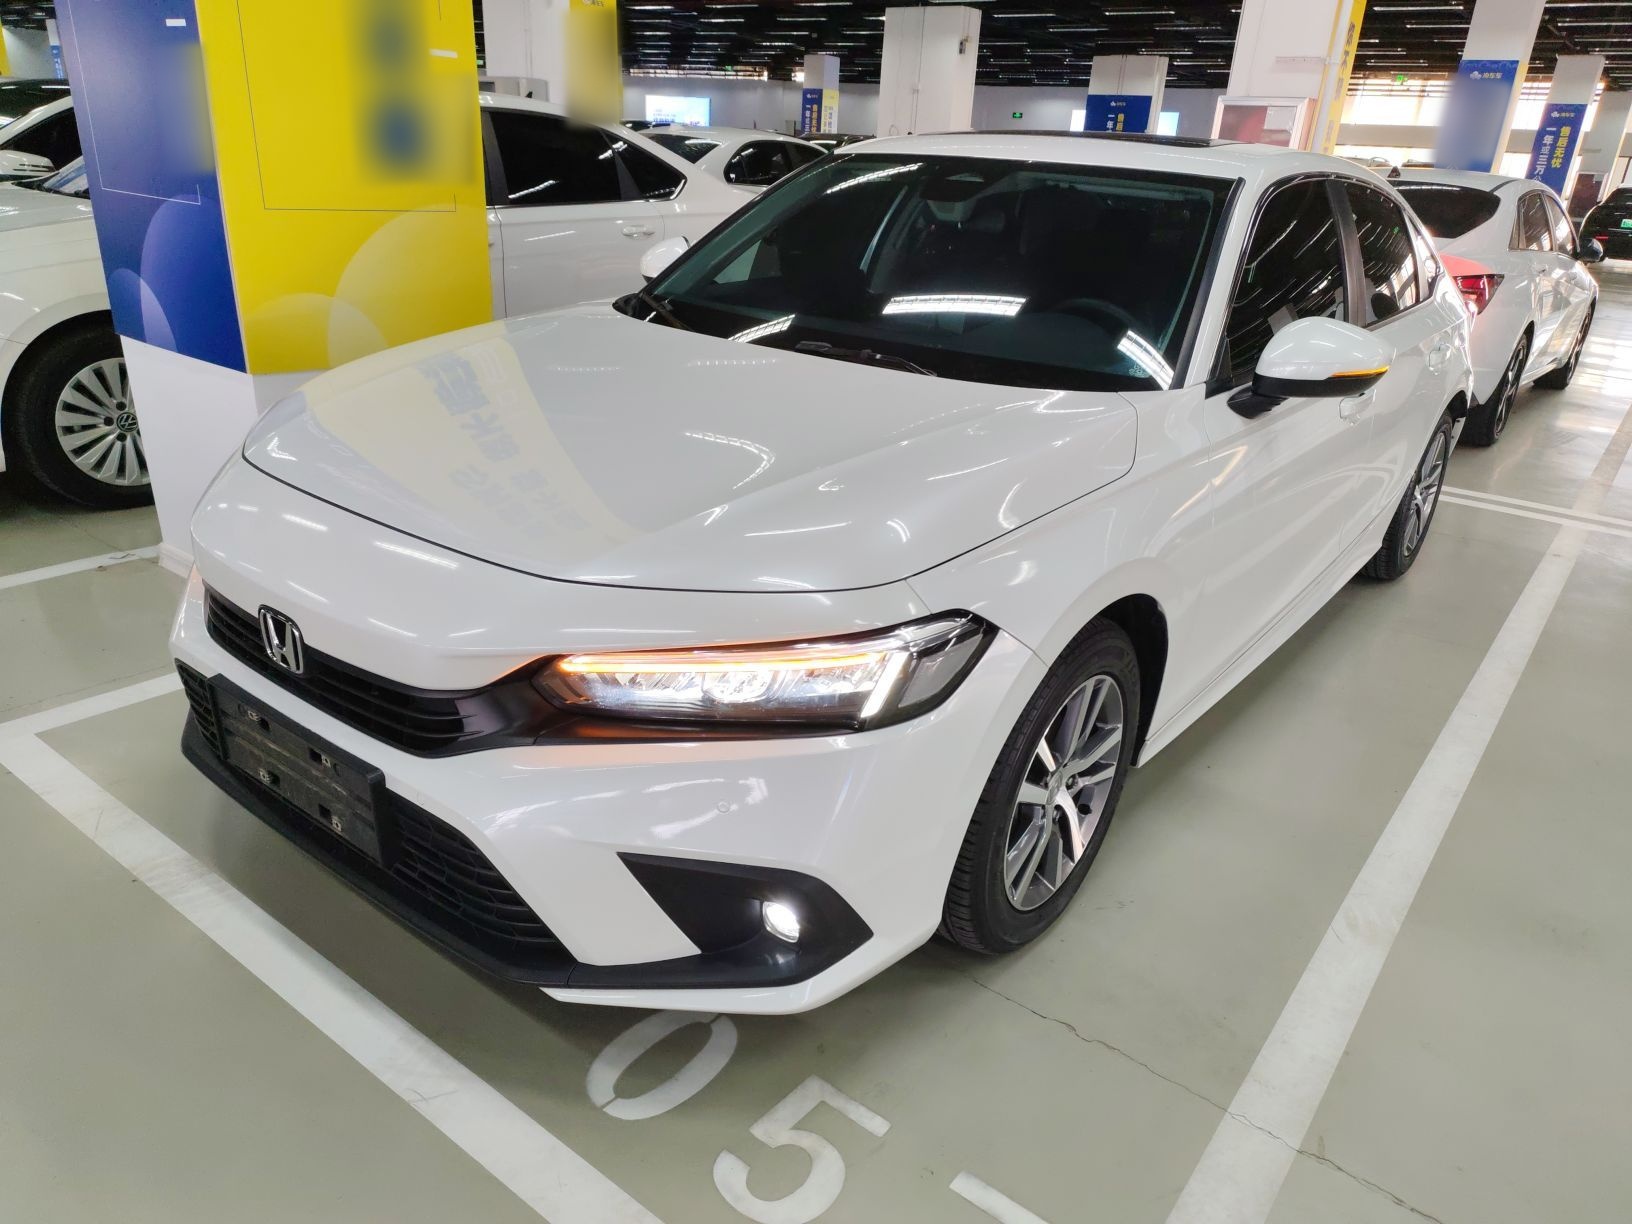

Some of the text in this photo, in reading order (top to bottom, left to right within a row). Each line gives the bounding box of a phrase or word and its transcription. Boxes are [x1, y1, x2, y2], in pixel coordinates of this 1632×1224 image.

[1550, 126, 1571, 168] 售后无忧
[586, 1010, 1050, 1224] 05
